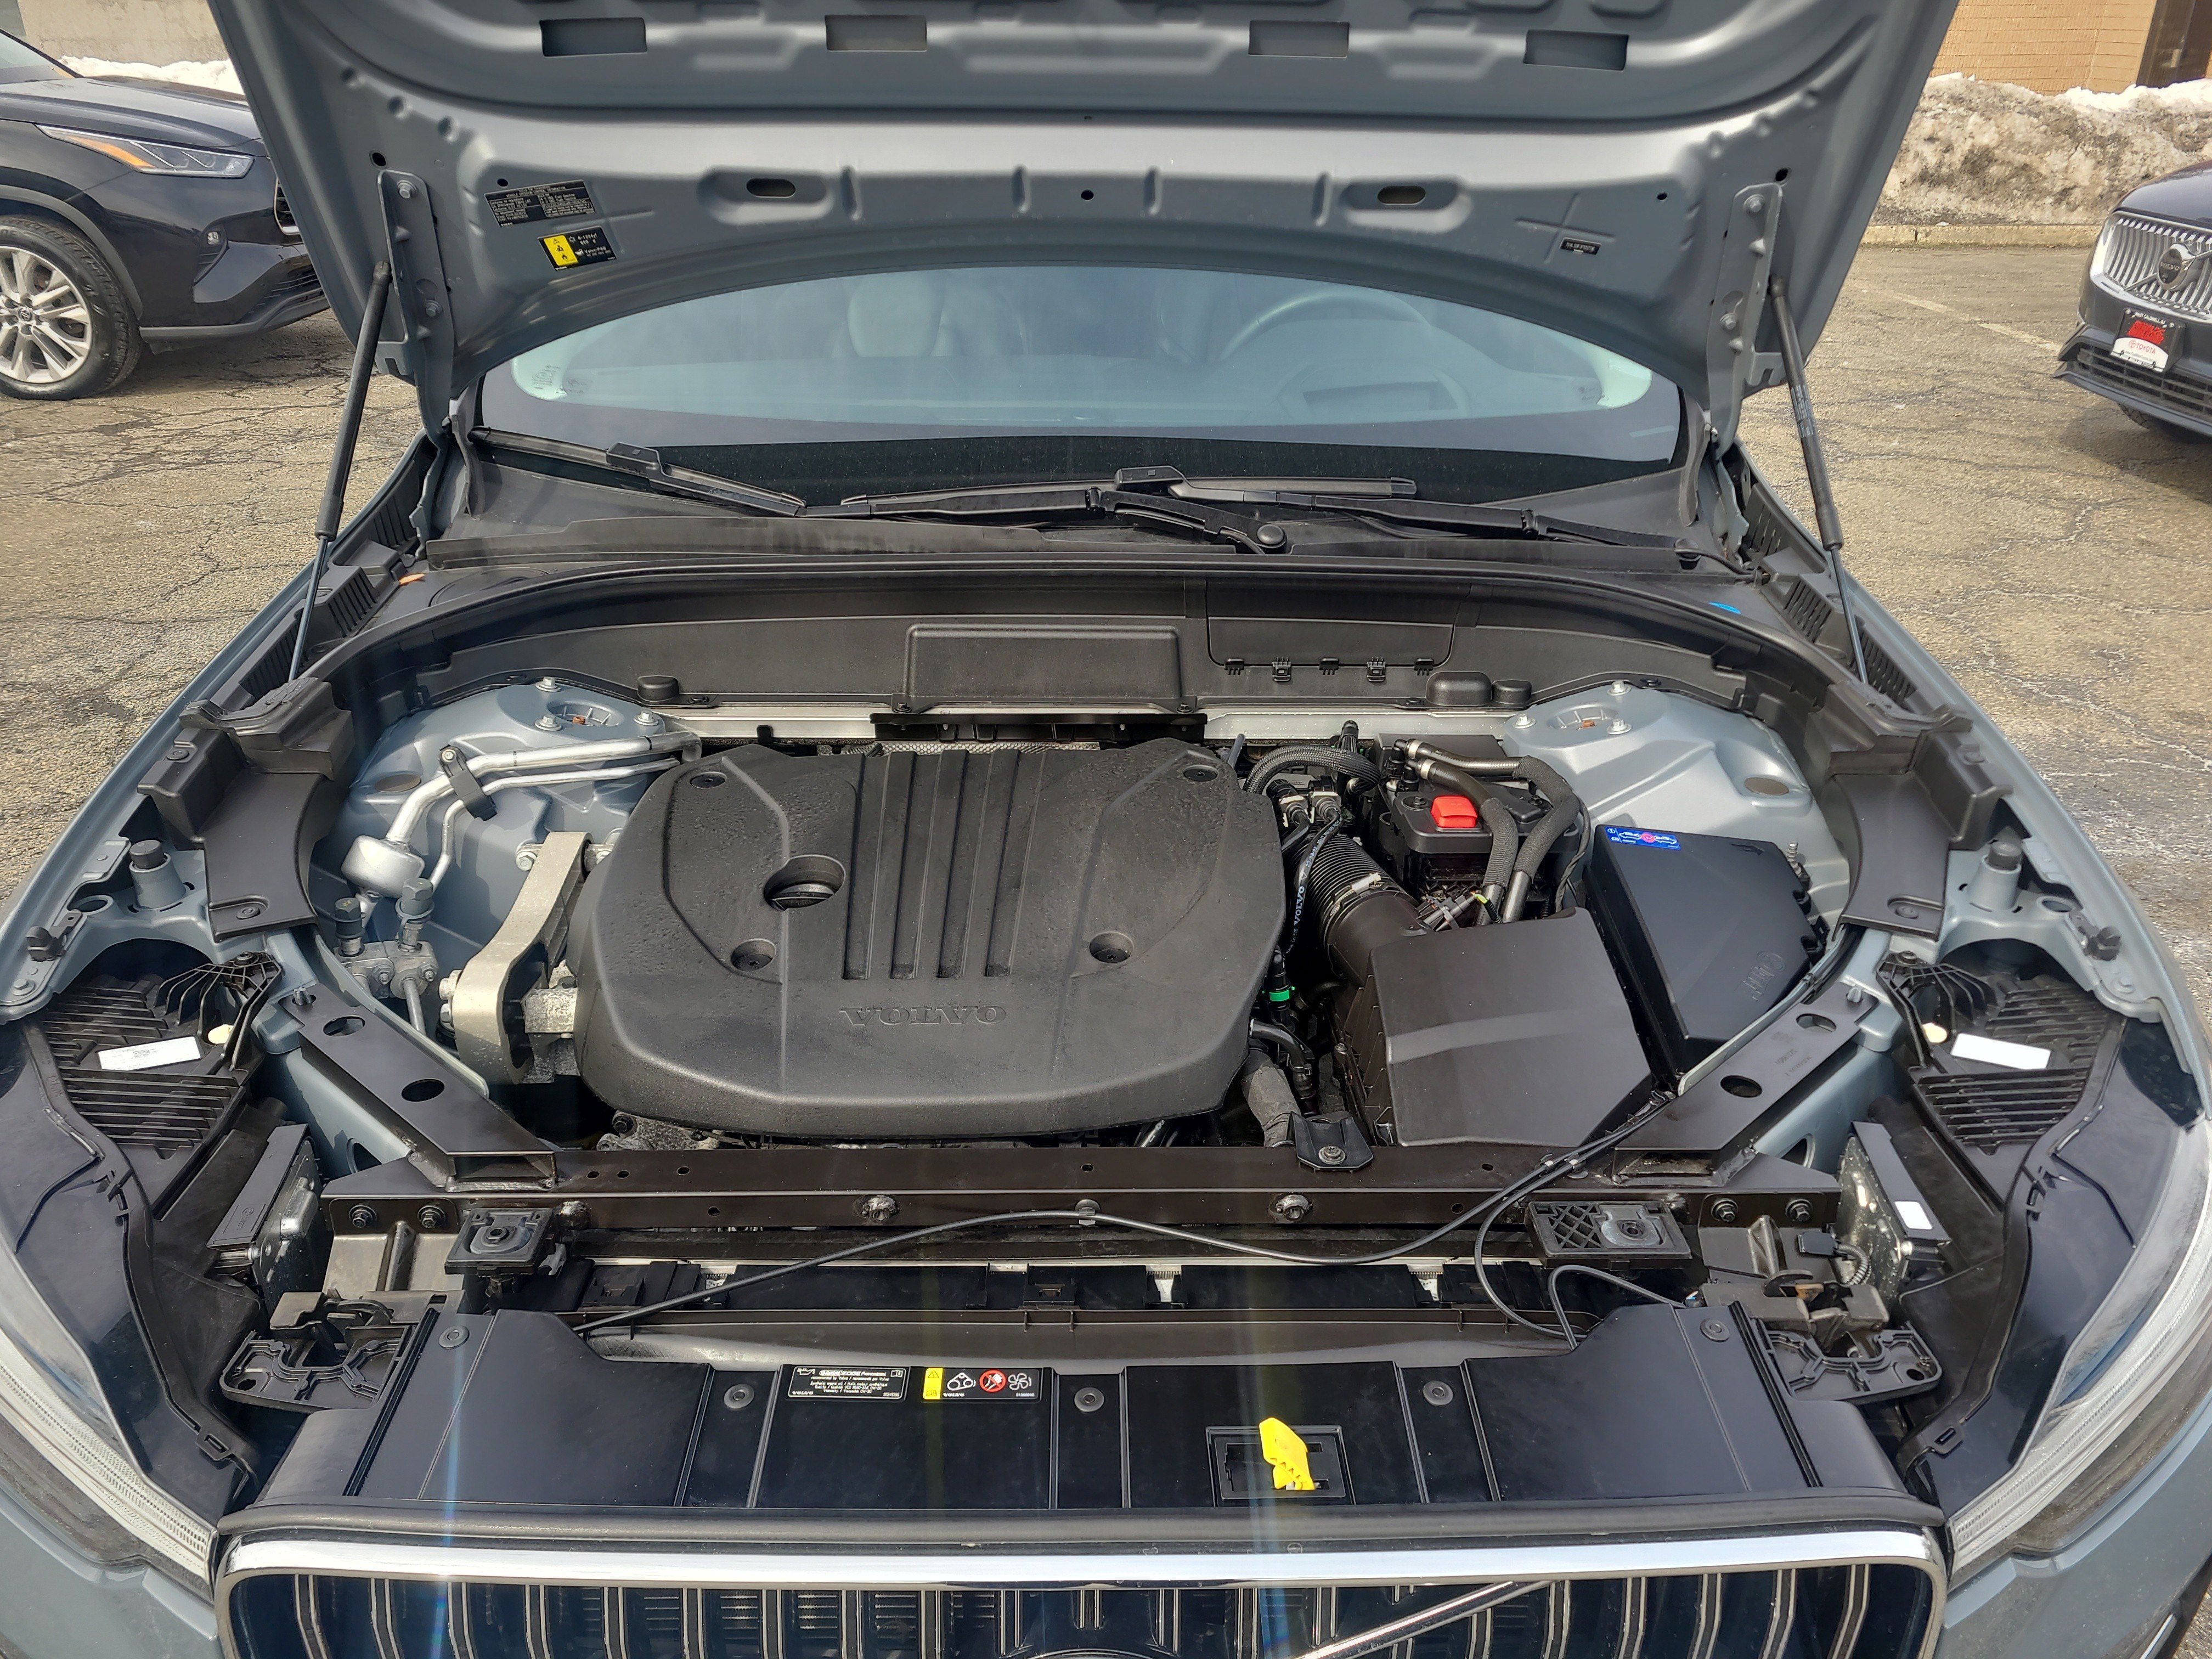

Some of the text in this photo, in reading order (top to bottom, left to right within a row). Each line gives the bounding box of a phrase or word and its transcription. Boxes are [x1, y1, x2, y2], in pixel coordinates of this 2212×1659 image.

[2160, 262, 2180, 271] VOLVO
[2136, 343, 2156, 354] TOYOTA
[1294, 885, 1305, 926] VOLVO
[839, 1005, 1007, 1026] VOLVO
